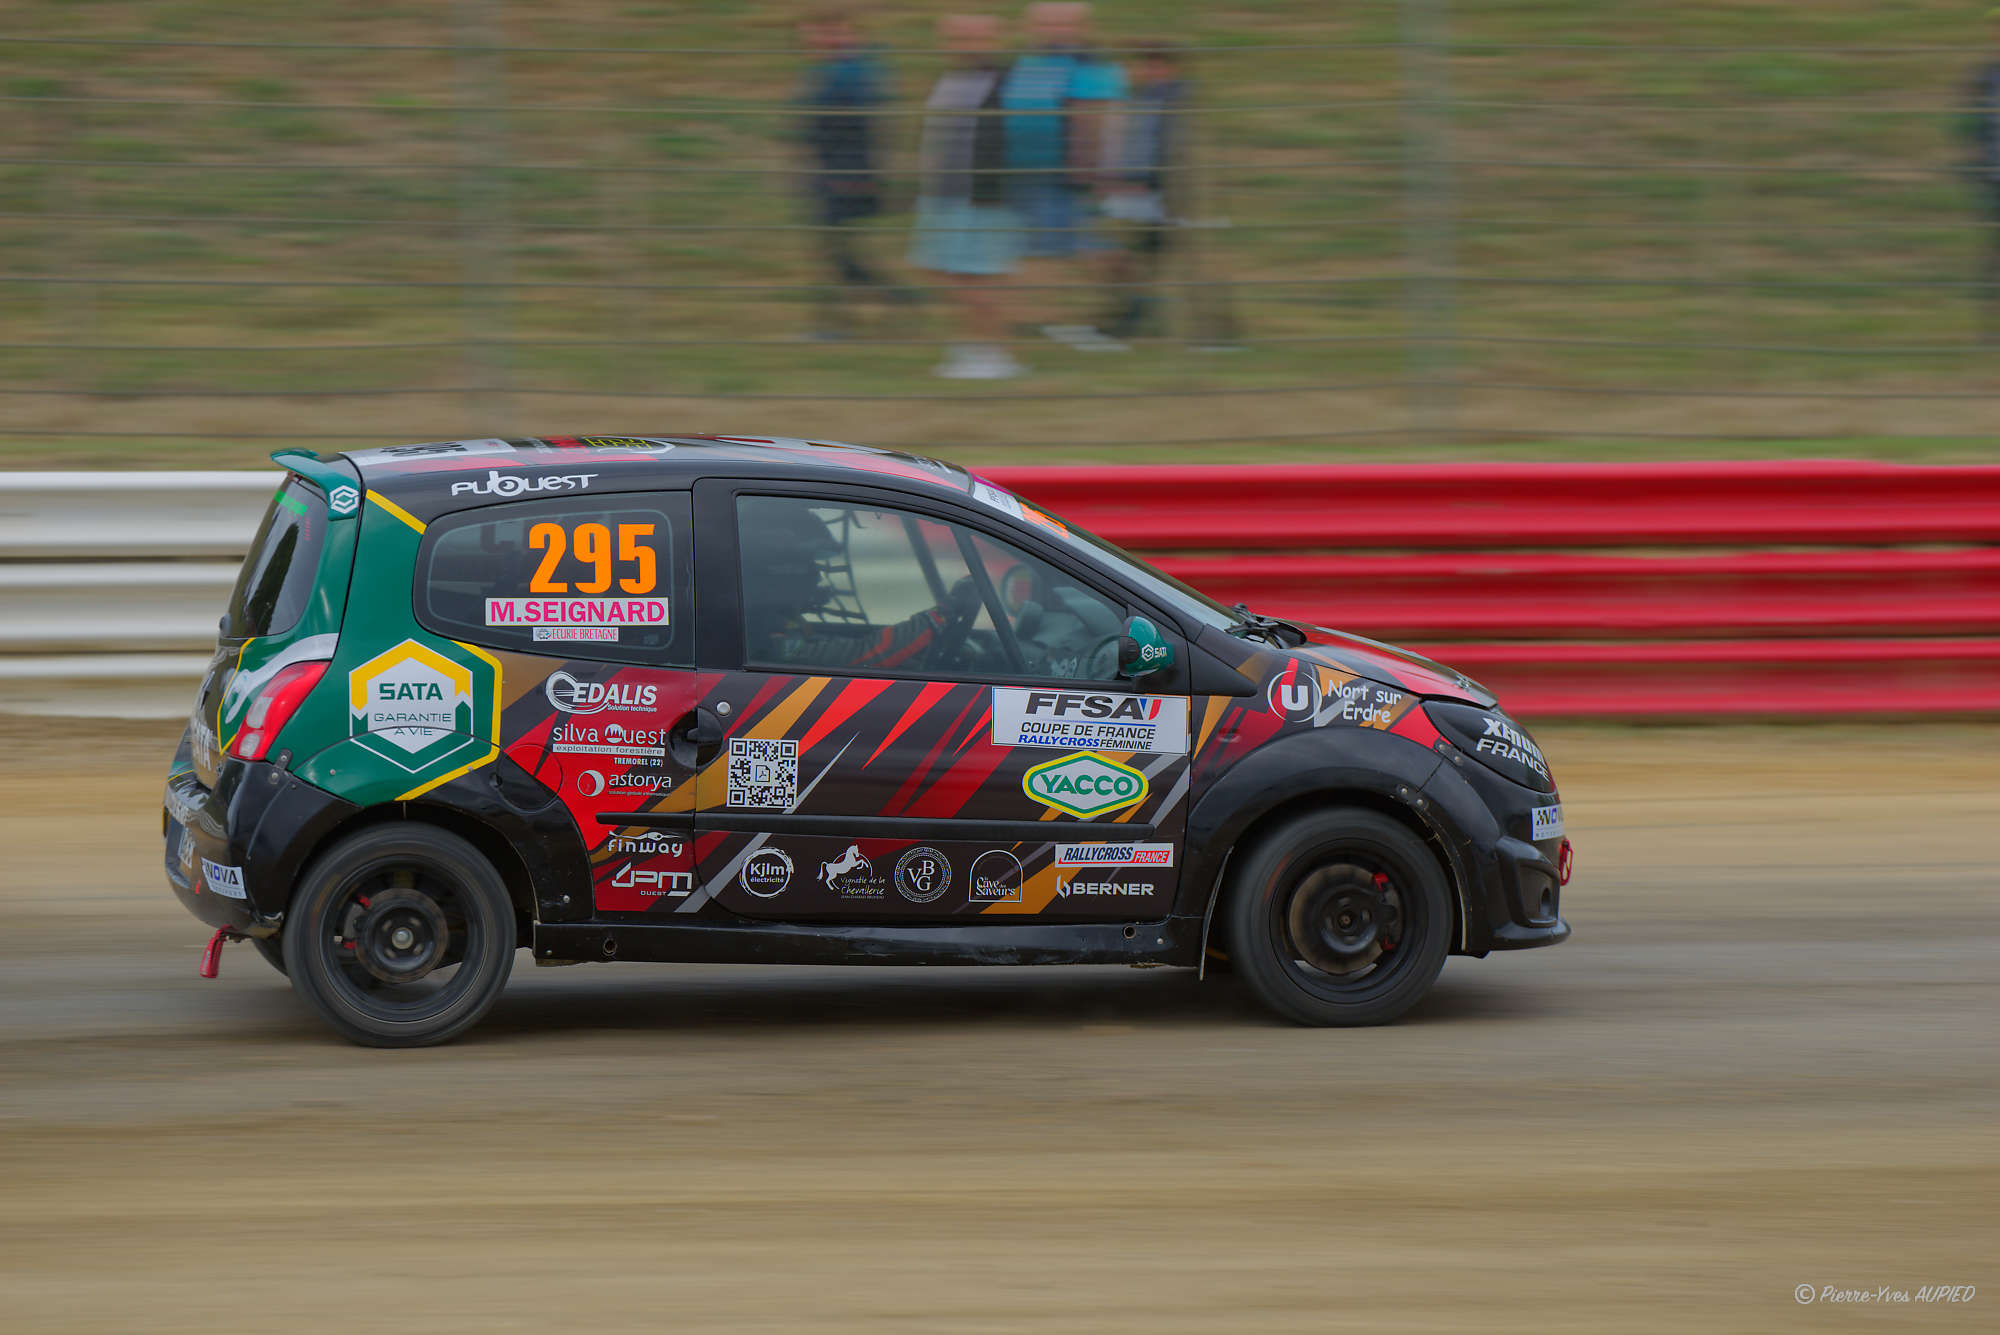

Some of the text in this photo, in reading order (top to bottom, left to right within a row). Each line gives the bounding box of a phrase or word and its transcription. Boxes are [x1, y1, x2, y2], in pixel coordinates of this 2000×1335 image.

[529, 522, 657, 594] 295
[490, 601, 666, 623] M.SEIGNARD
[552, 628, 617, 641] ECURIE BRETAGNE
[379, 682, 444, 701] SATA
[1280, 684, 1309, 711] U
[1327, 679, 1402, 705] Nort sur
[1024, 692, 1144, 721] FFSA
[1342, 701, 1392, 724] Erdre
[373, 712, 452, 723] GARANTIE
[410, 727, 433, 736] VIE
[552, 723, 600, 743] silva
[1020, 721, 1156, 740] COUPE DE FRANCE
[556, 744, 613, 755] exploitation
[1018, 734, 1100, 748] RALLYCROSS
[613, 757, 664, 768] TREMOREL (22)
[1476, 737, 1550, 783] FRANCE
[608, 773, 672, 792] astorya
[1040, 774, 1133, 796] YACCO
[608, 838, 683, 858] finway
[1064, 846, 1167, 863] RALLYCROSS FRANCE
[1072, 882, 1155, 896] BERNER
